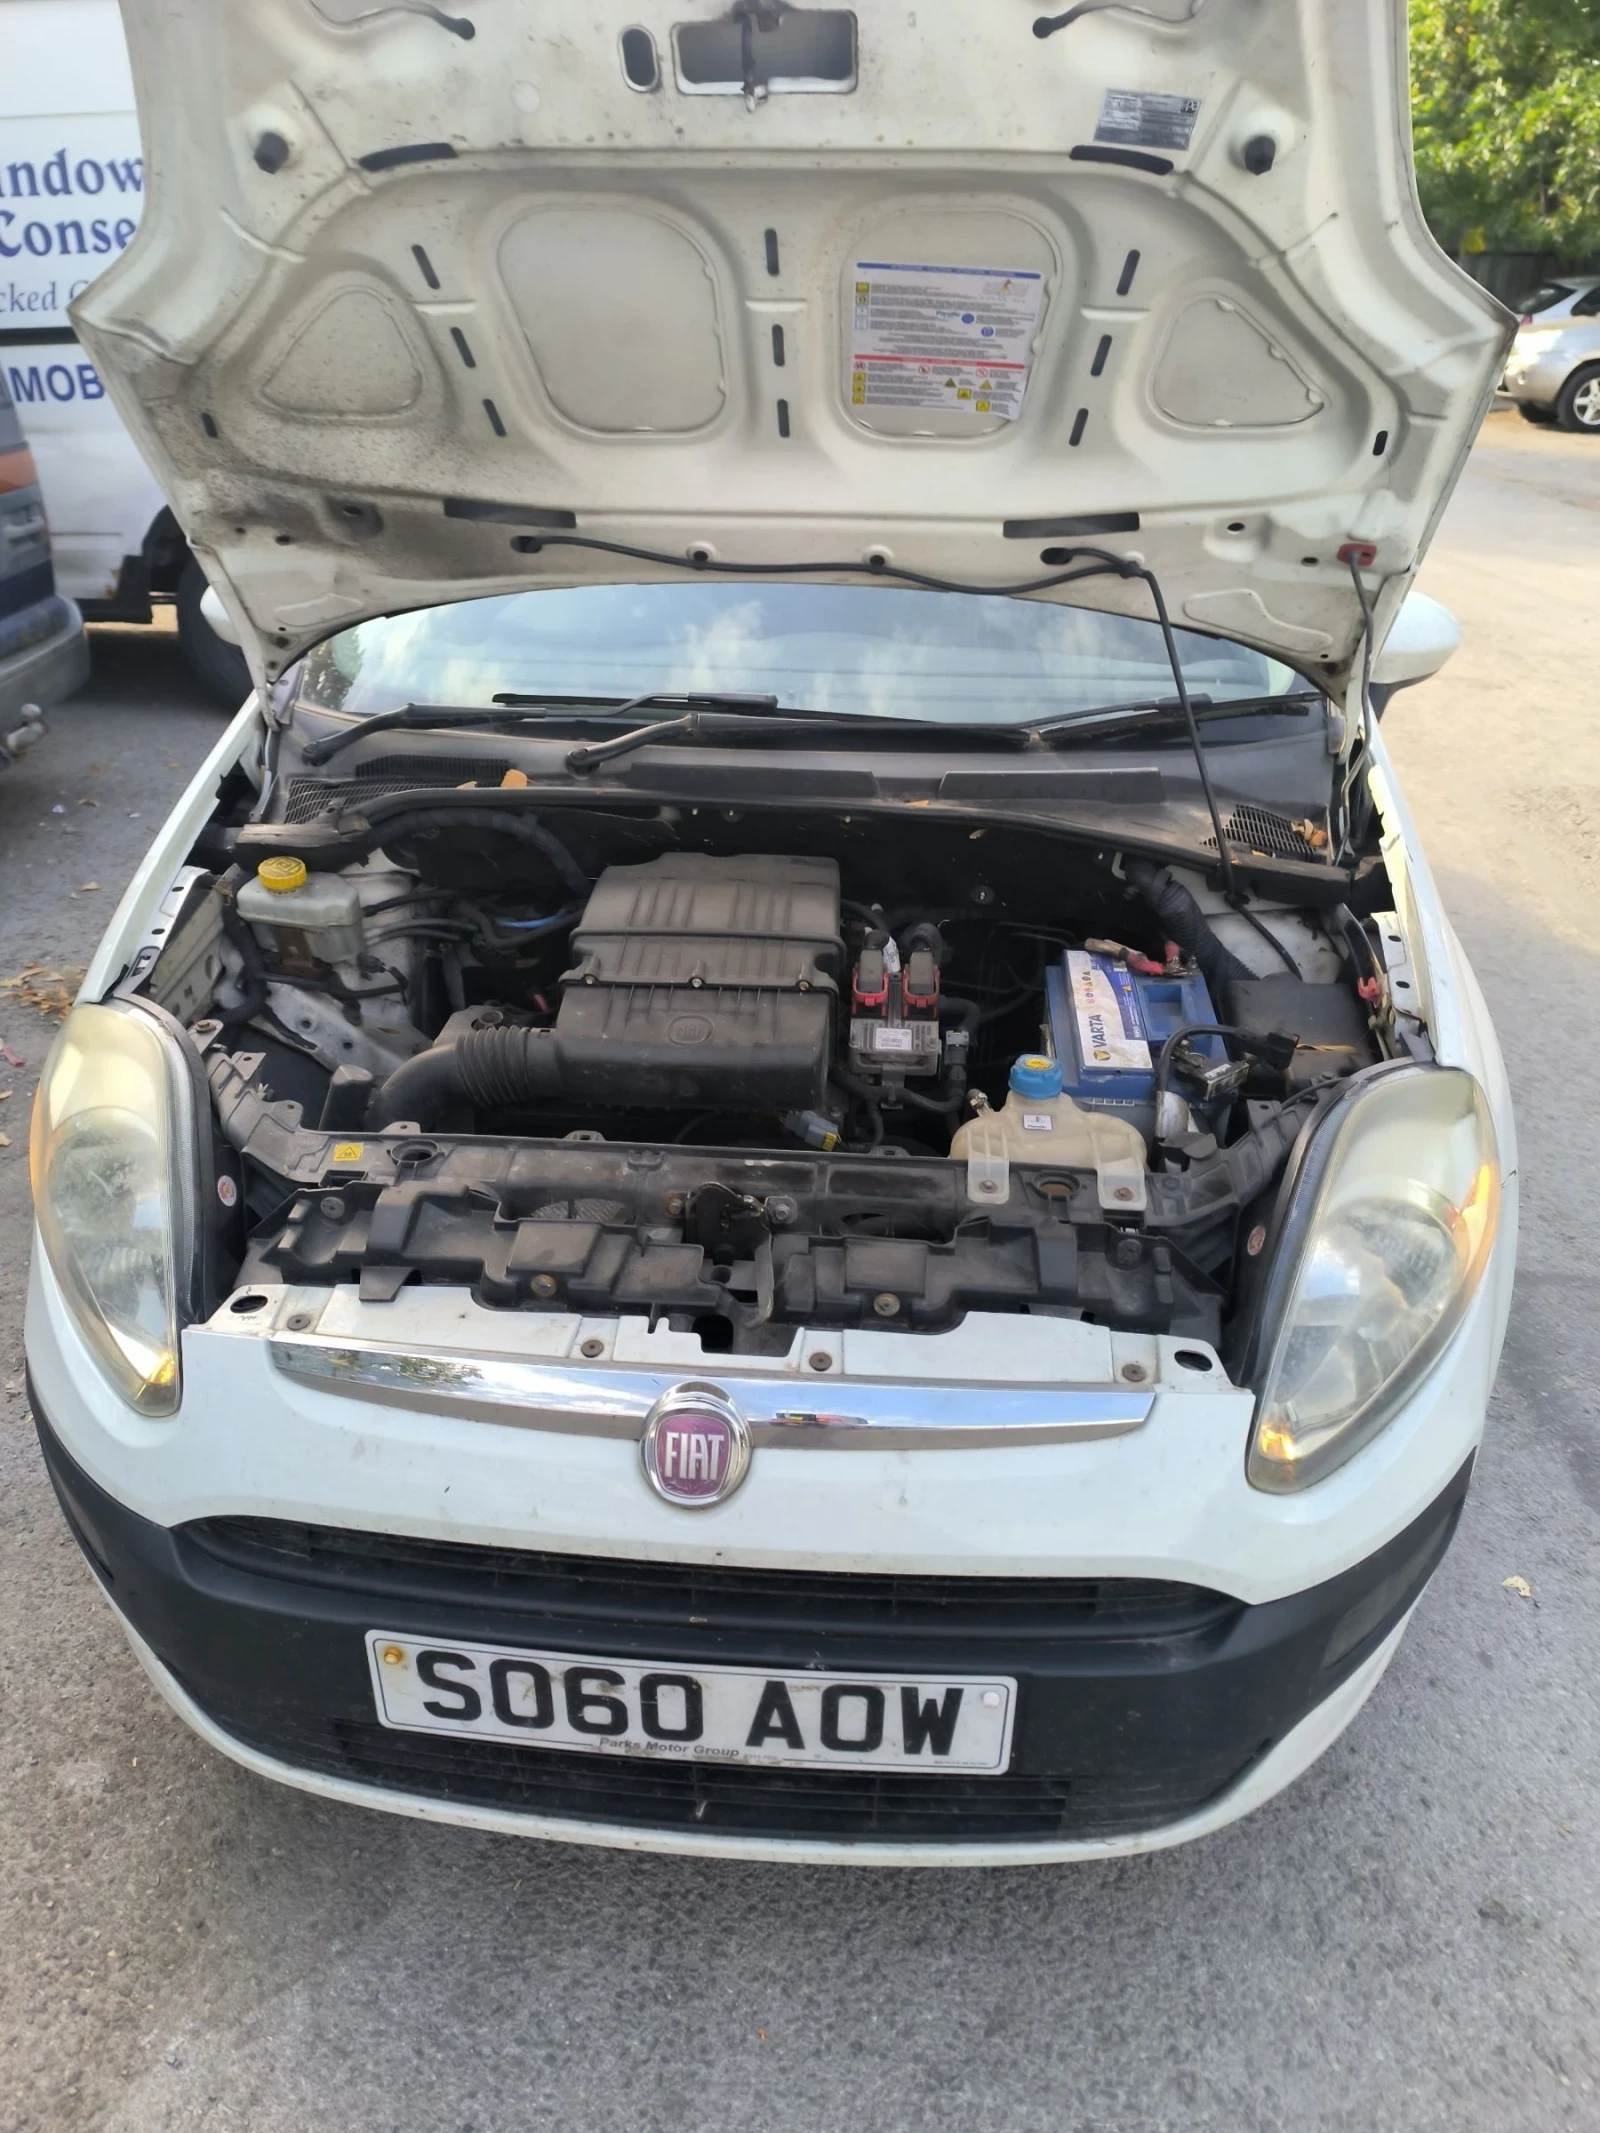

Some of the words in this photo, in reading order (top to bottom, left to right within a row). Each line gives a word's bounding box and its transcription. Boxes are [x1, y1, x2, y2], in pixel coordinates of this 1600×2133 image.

[0, 148, 143, 198] ndow
[8, 364, 105, 403] MOB
[1088, 1014, 1107, 1048] VARTA
[664, 1431, 724, 1480] FIAT
[415, 1649, 704, 1742] SO60
[744, 1680, 964, 1756] AOW
[600, 1737, 641, 1750] Parks
[646, 1741, 689, 1754] Motor
[693, 1745, 740, 1757] Group
